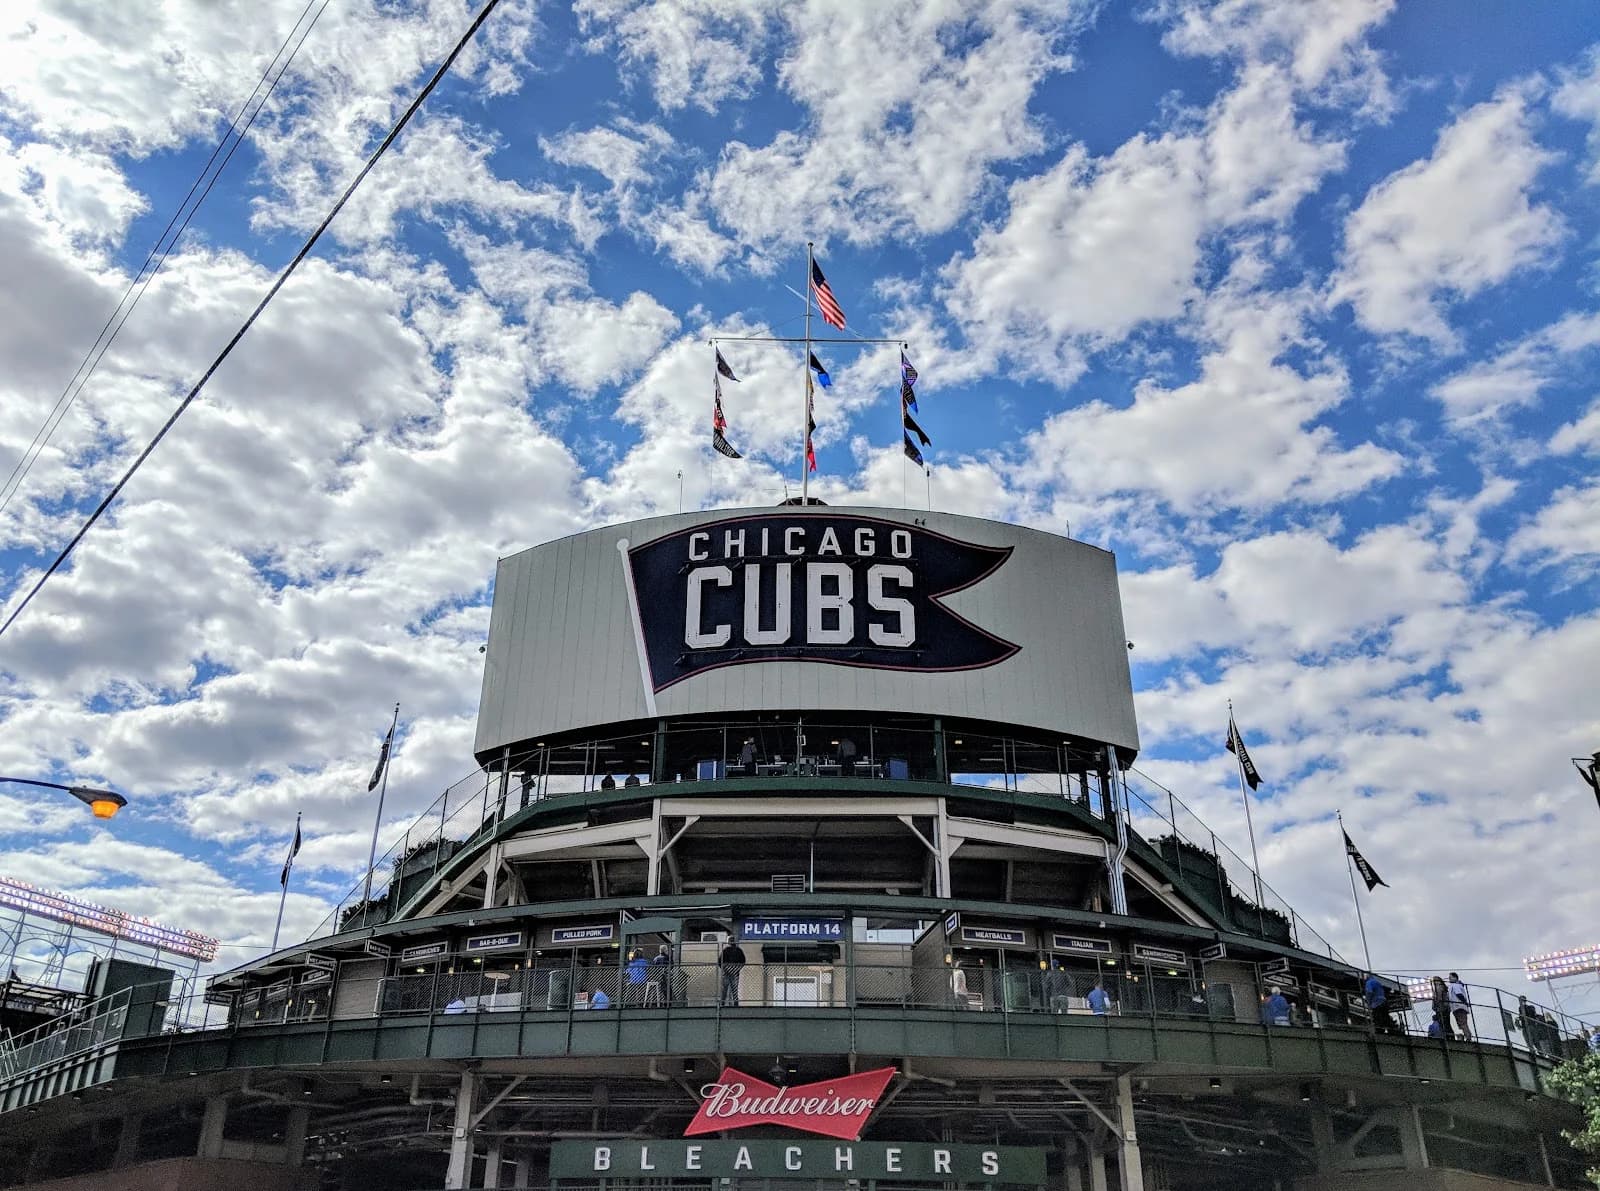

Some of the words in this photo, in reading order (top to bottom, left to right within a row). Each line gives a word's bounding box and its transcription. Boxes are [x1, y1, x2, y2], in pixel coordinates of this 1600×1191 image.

[688, 527, 912, 561] CHICAGO
[685, 562, 916, 649] CUBS
[562, 931, 586, 939] PULLED
[744, 923, 820, 935] PLATFORM
[824, 923, 840, 935] 14
[975, 931, 1012, 940] MEATBALLS
[1071, 940, 1094, 948] ITALIAN
[700, 1083, 875, 1117] Budweiser
[594, 1146, 1000, 1176] BLEACHERS
